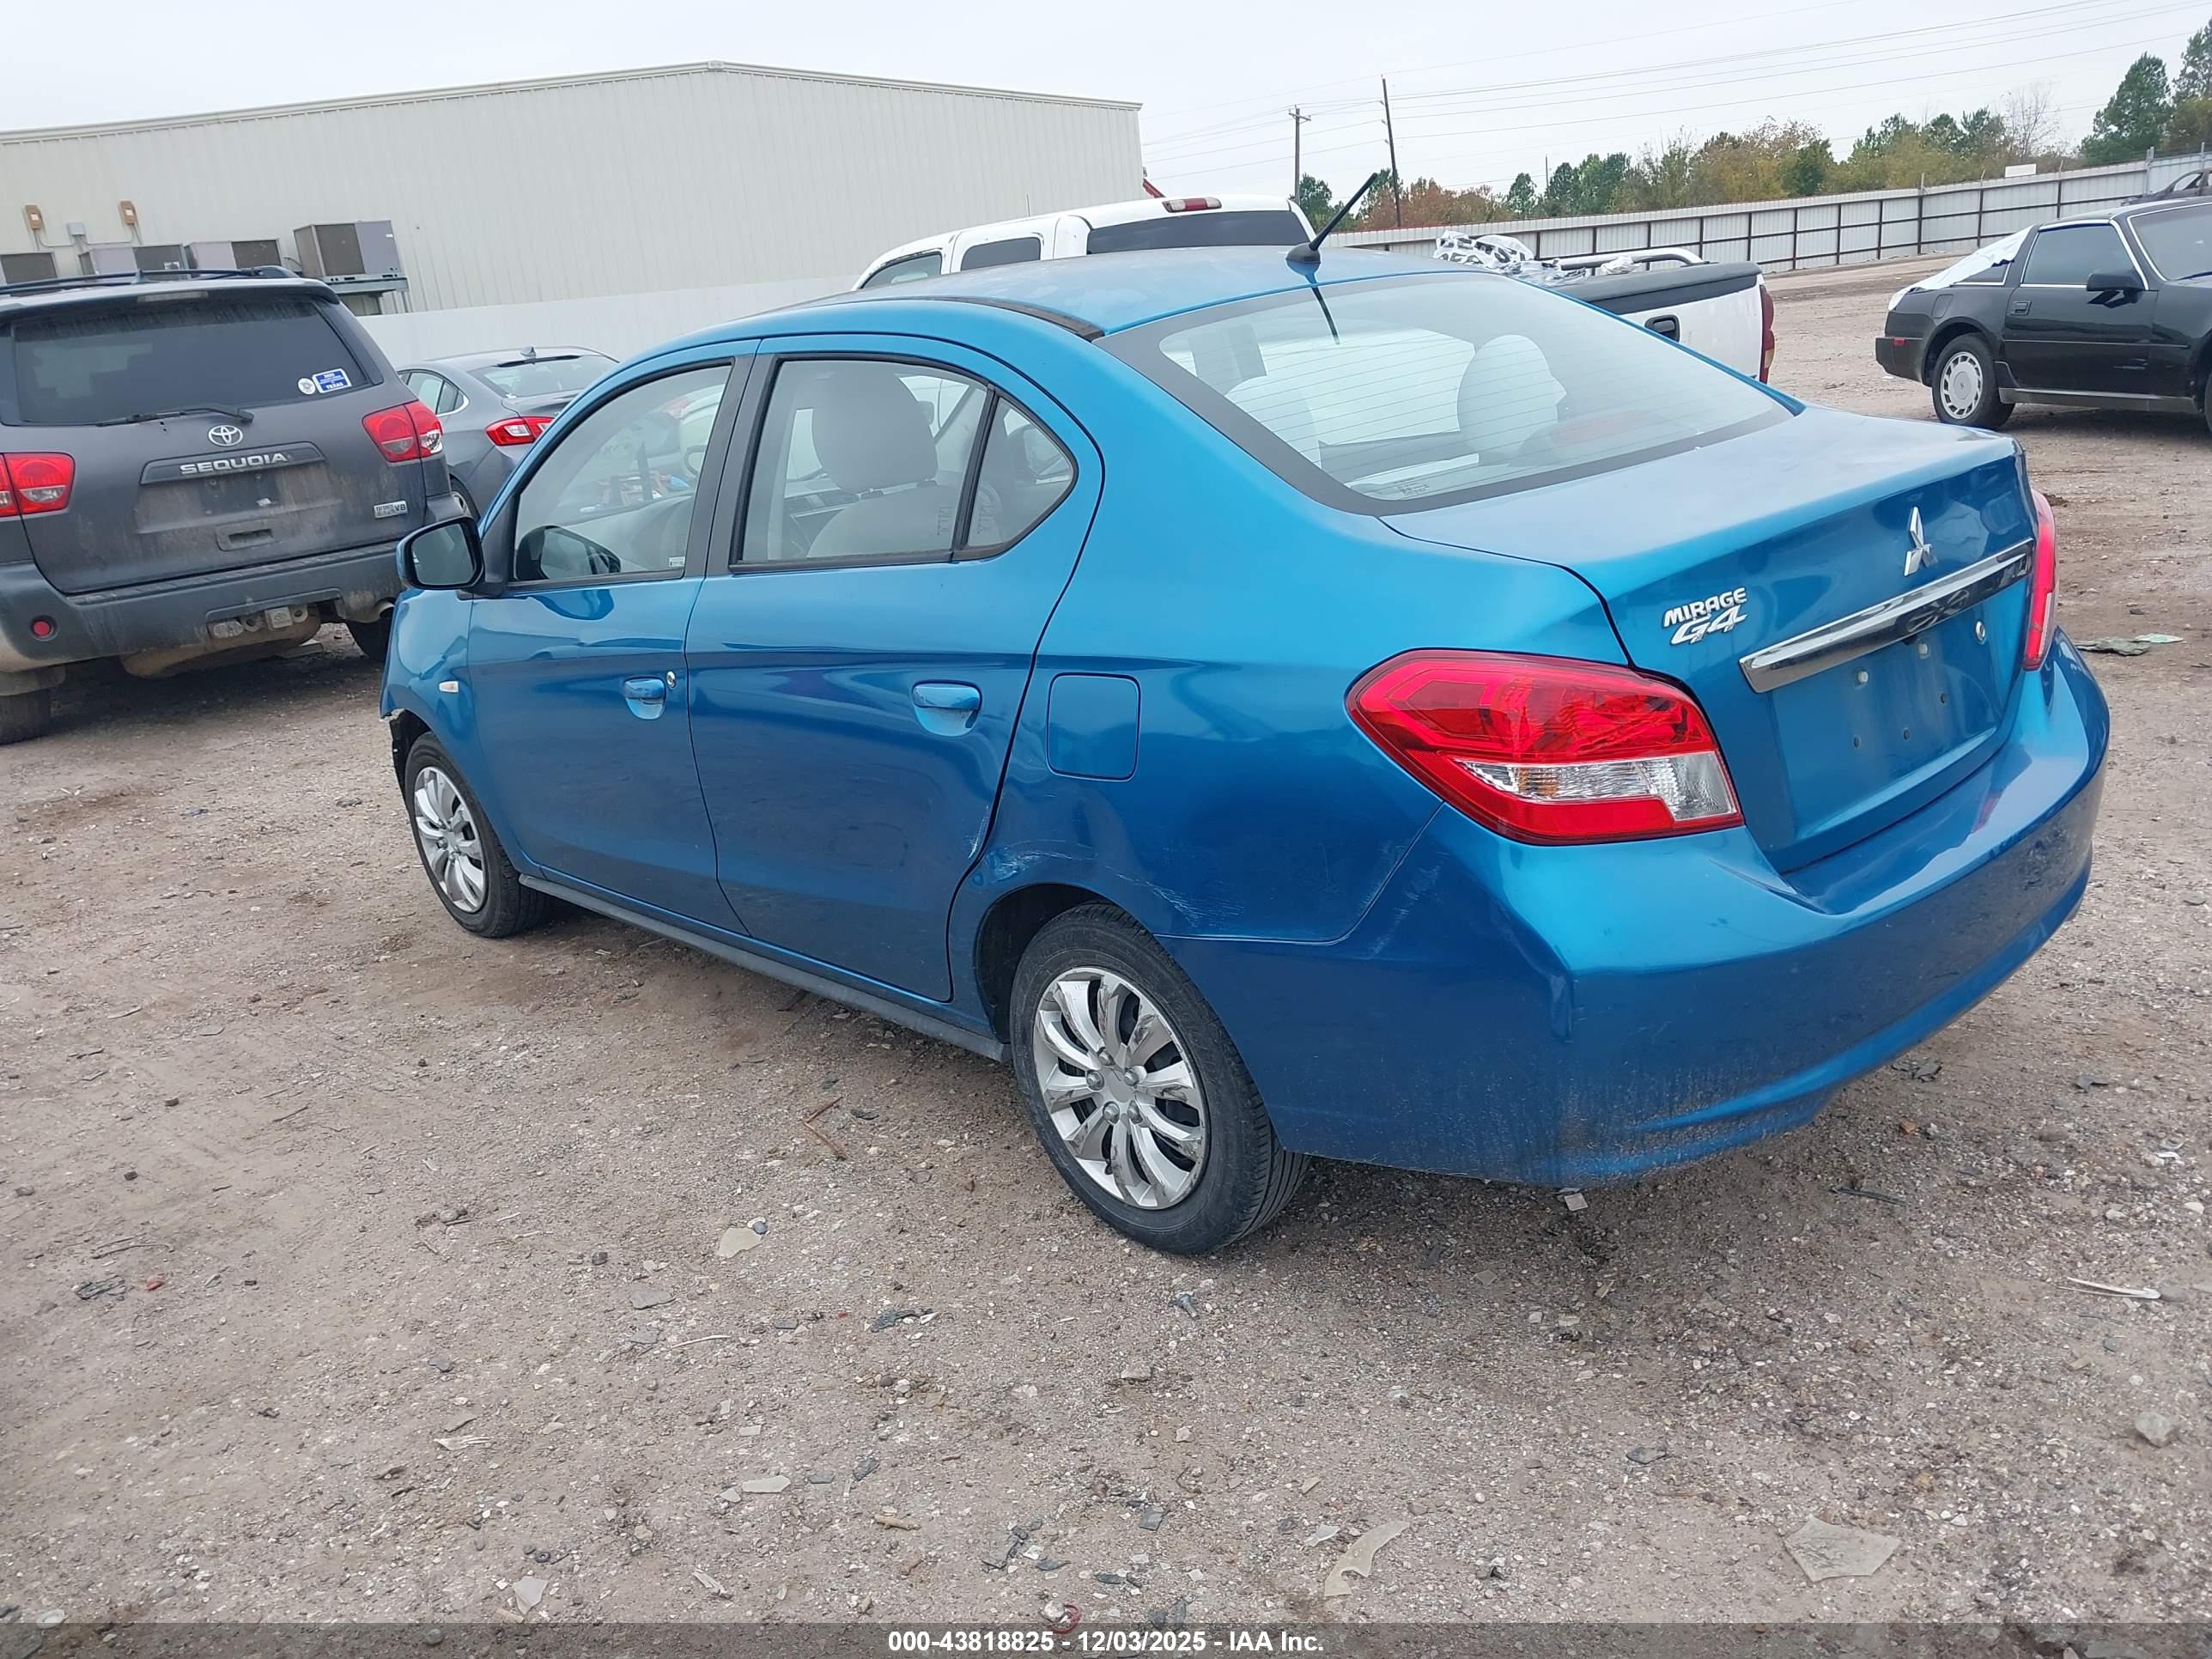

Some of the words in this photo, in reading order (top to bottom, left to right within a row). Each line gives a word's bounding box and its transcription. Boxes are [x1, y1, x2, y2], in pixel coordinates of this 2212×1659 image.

[179, 453, 288, 475] SEQUOIA
[1663, 587, 1747, 627] MIRAGE
[1671, 605, 1747, 644] G4
